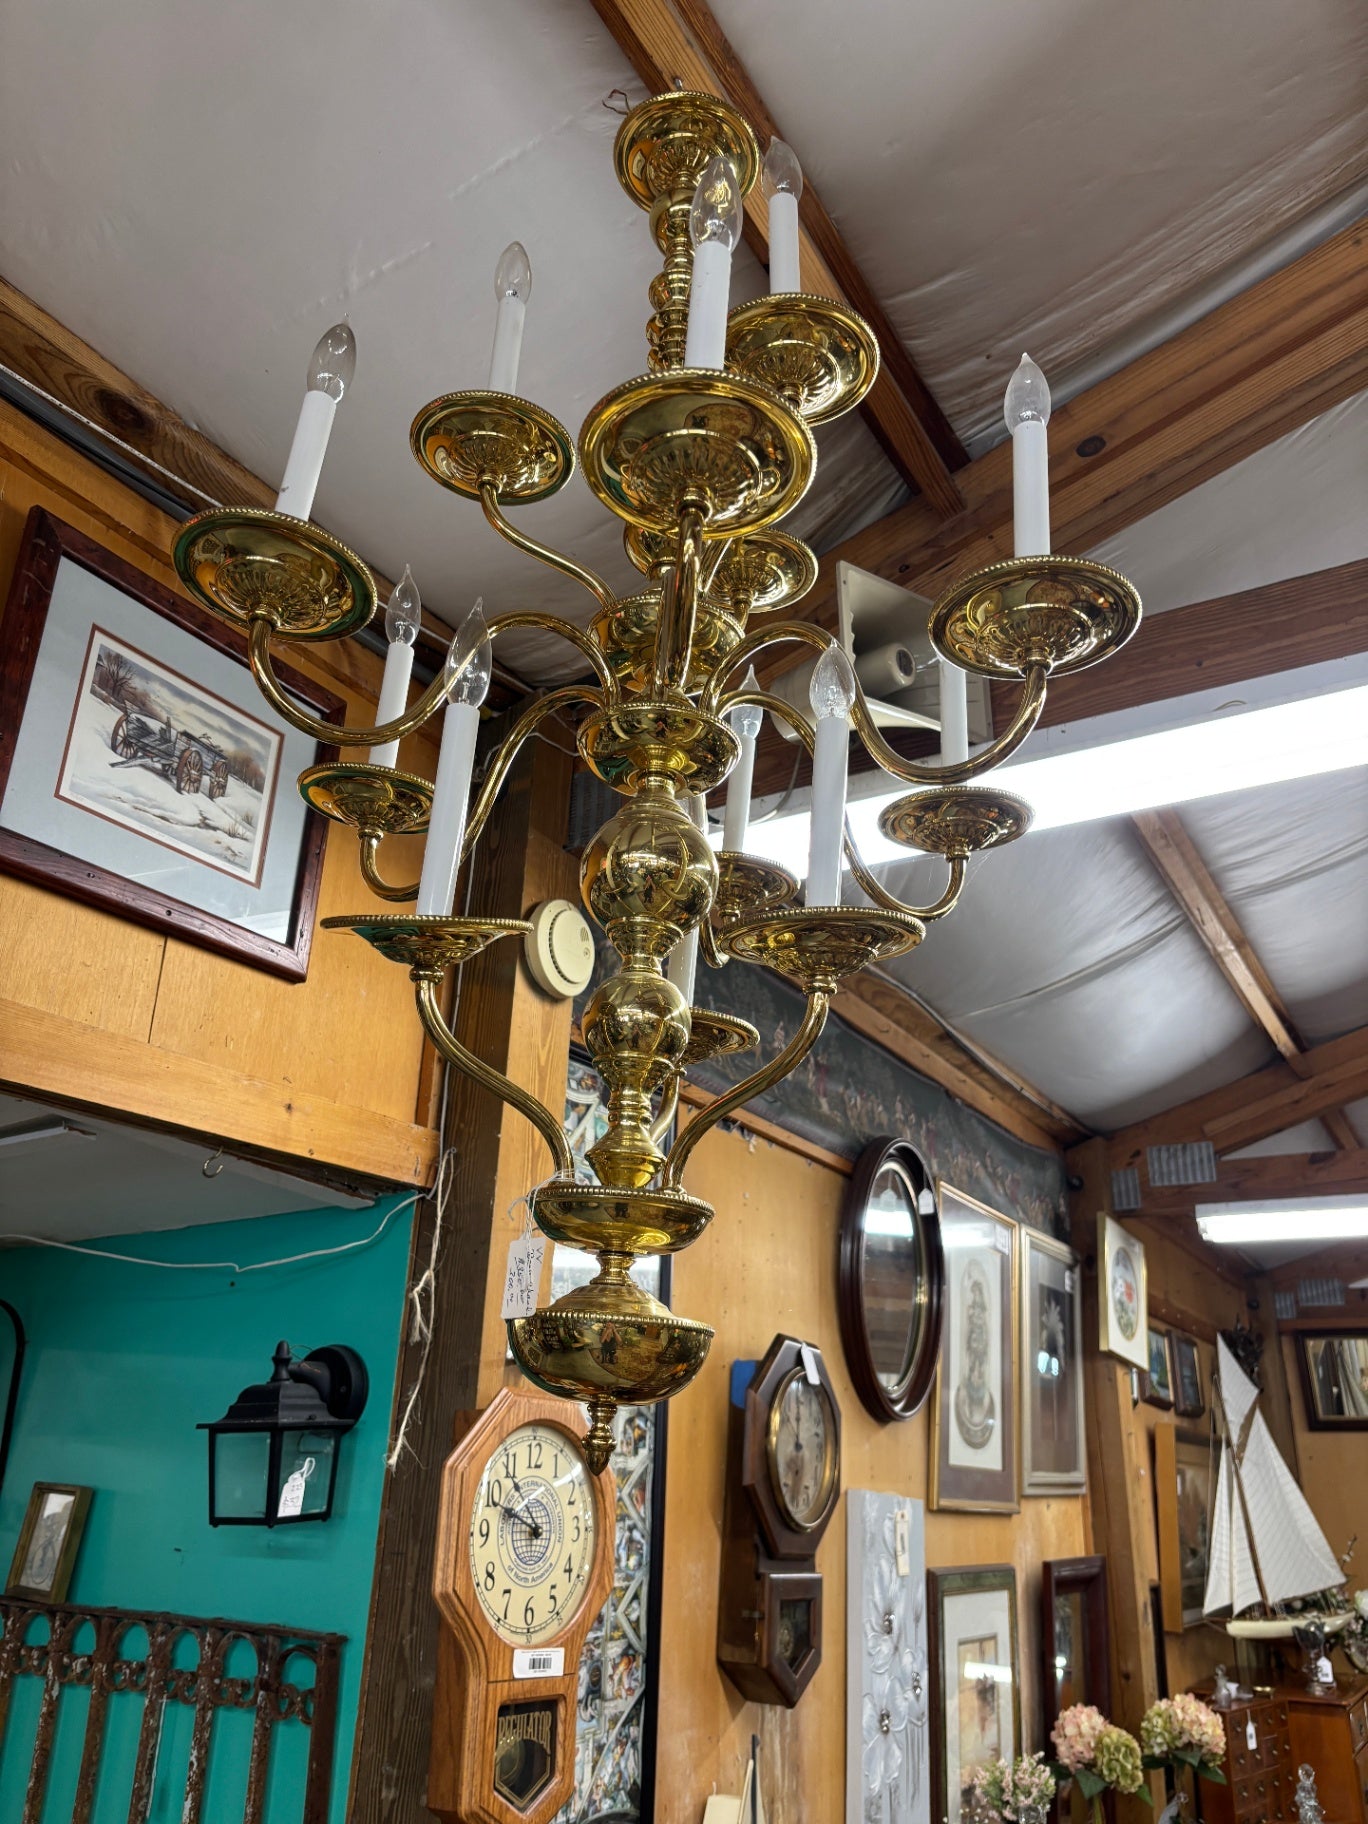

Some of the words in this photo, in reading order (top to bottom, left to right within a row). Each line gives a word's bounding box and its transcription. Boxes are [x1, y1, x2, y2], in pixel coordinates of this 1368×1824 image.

[504, 1452, 517, 1479] 11
[527, 1442, 543, 1469] 12
[553, 1453, 559, 1479] 1
[485, 1479, 502, 1508] 10
[567, 1479, 577, 1506] 2
[479, 1518, 490, 1548] 9
[571, 1515, 581, 1543] 3
[484, 1561, 495, 1592] 8
[530, 1562, 554, 1584] America
[563, 1552, 573, 1584] 4
[502, 1588, 512, 1620] 7
[524, 1595, 534, 1626] 6
[548, 1583, 557, 1614] 5
[498, 1710, 552, 1755] REGULATOR
